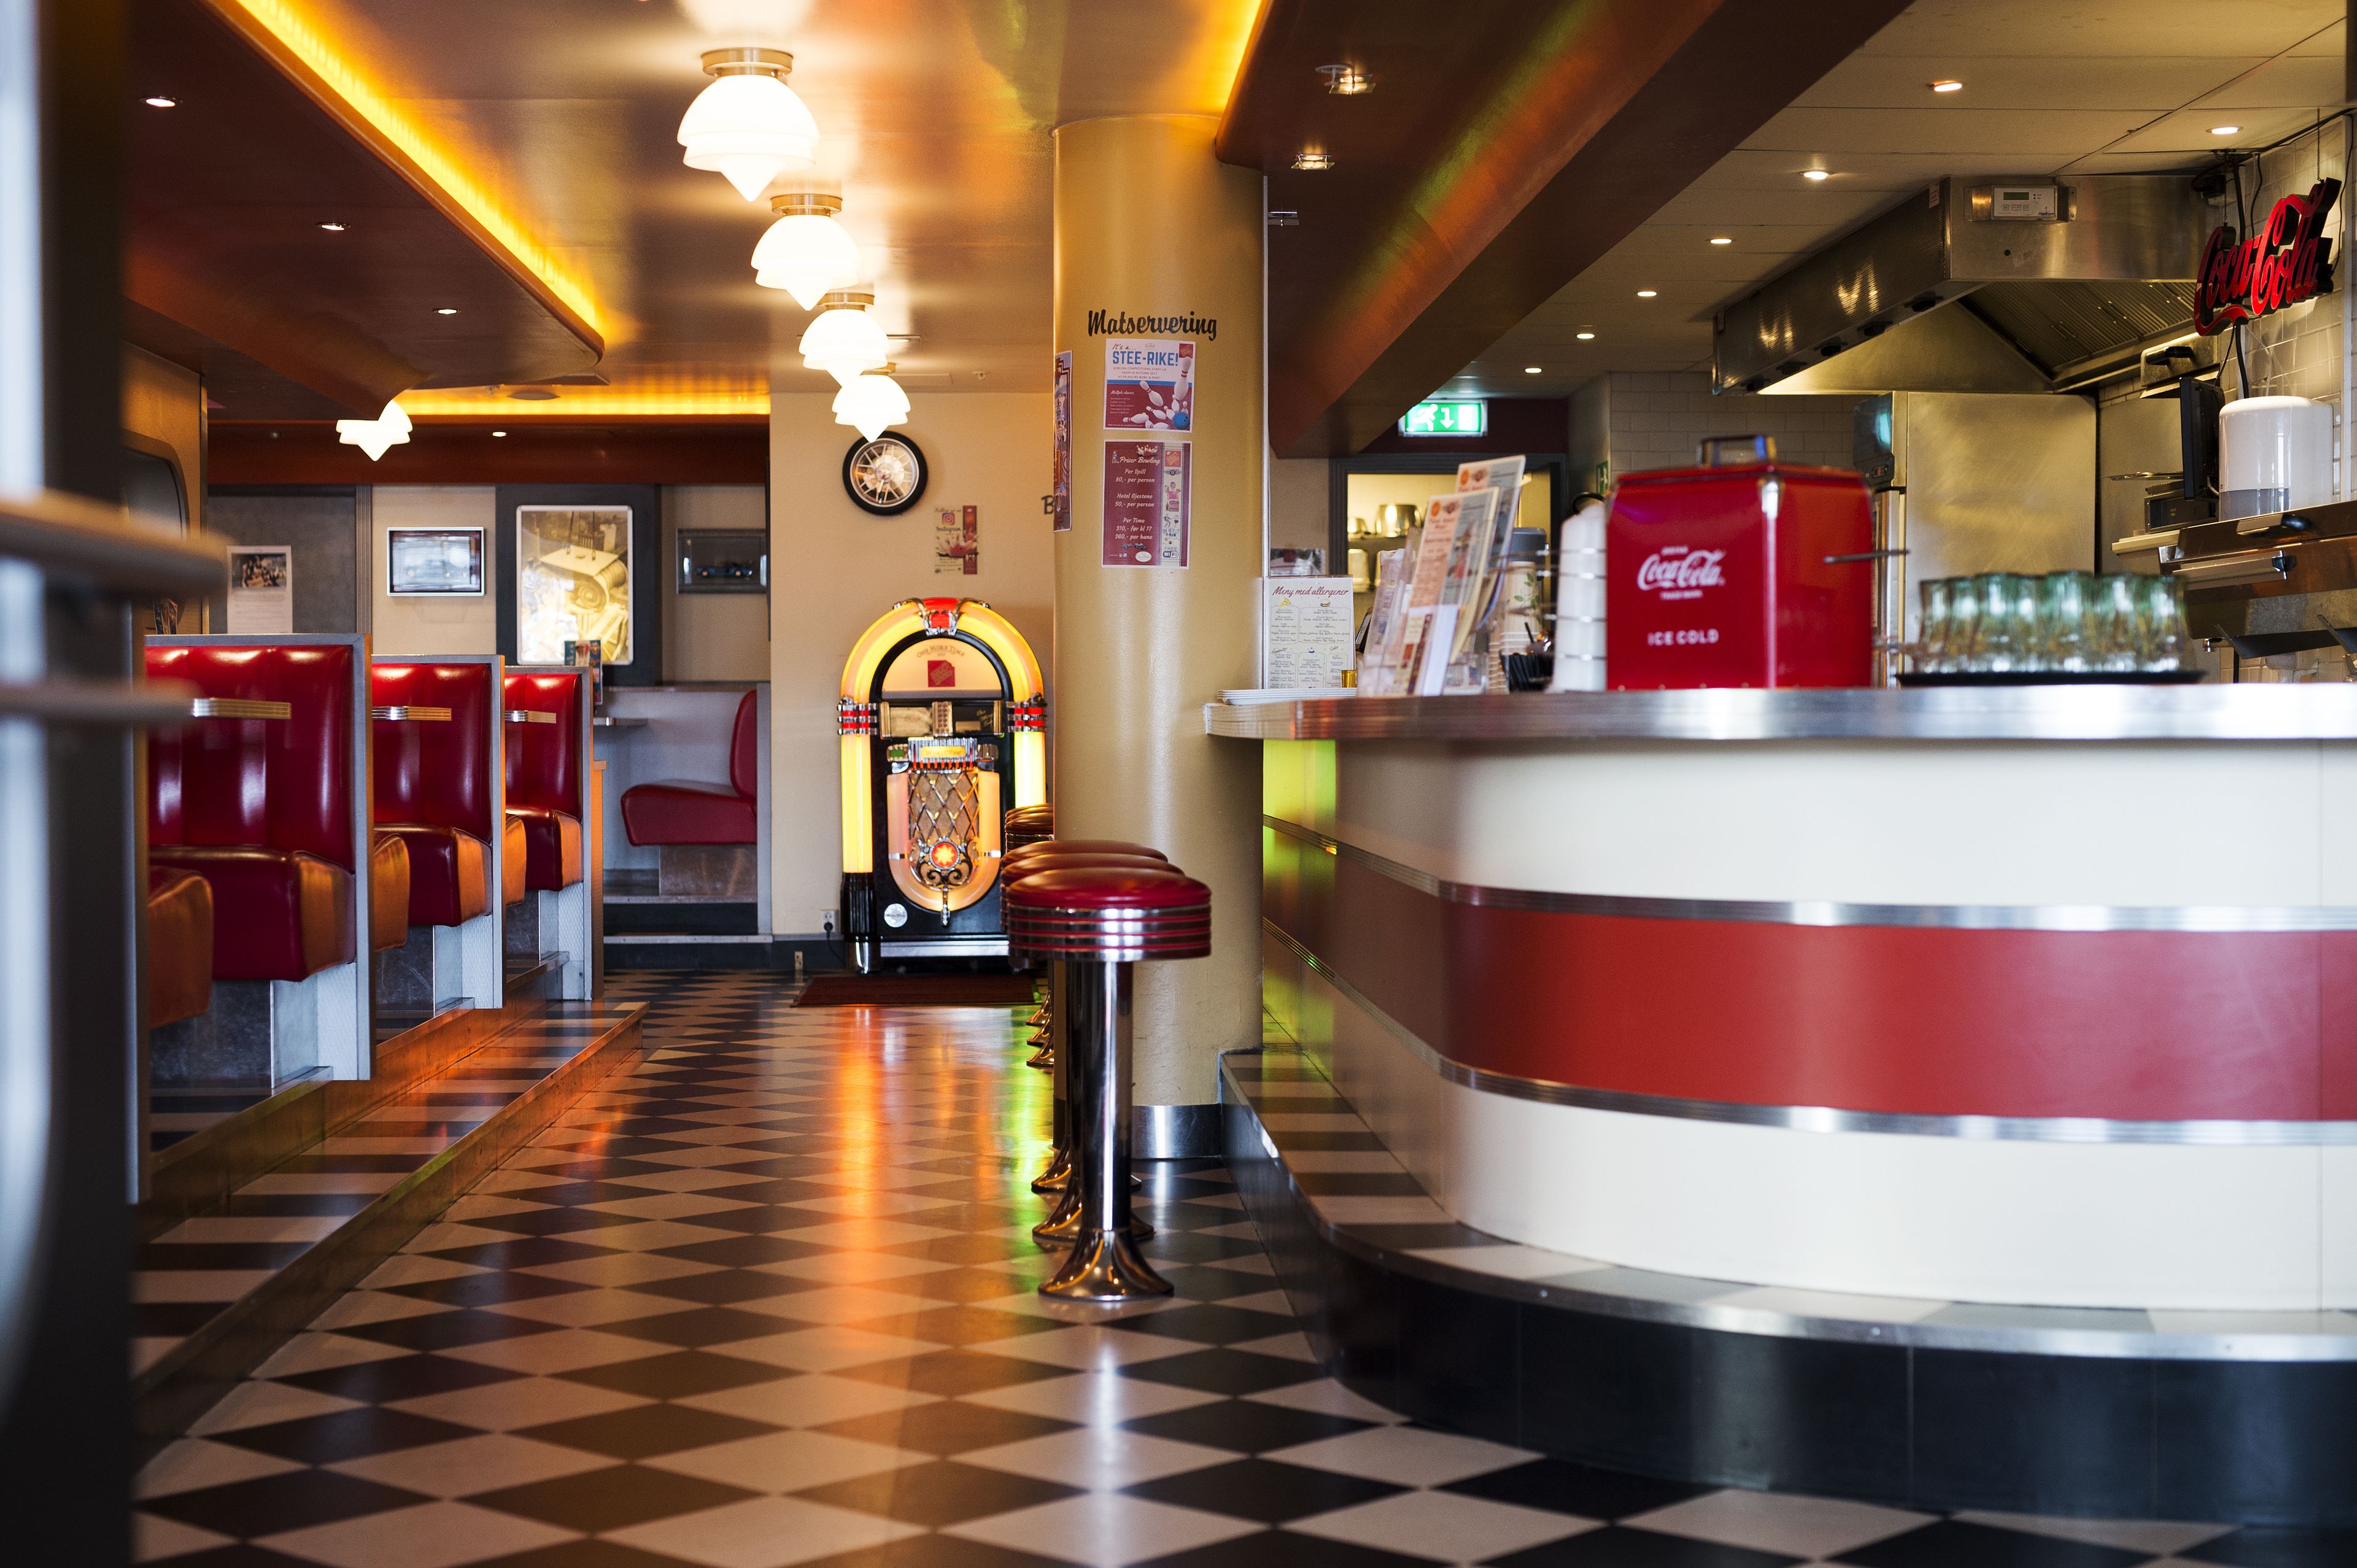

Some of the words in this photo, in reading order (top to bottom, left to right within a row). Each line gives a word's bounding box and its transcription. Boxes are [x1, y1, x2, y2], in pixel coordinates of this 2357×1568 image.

[2194, 178, 2340, 336] Coca-Cola
[1088, 309, 1217, 341] Matservering
[1112, 350, 1178, 366] STEE-RIKE!
[1137, 457, 1161, 466] Bowling
[1637, 549, 1726, 591] Coca-Cola
[1272, 586, 1294, 598] Meny
[1295, 586, 1312, 595] med
[1311, 586, 1349, 598] allergener
[1647, 630, 1674, 646] ICE
[1676, 628, 1719, 644] COLD
